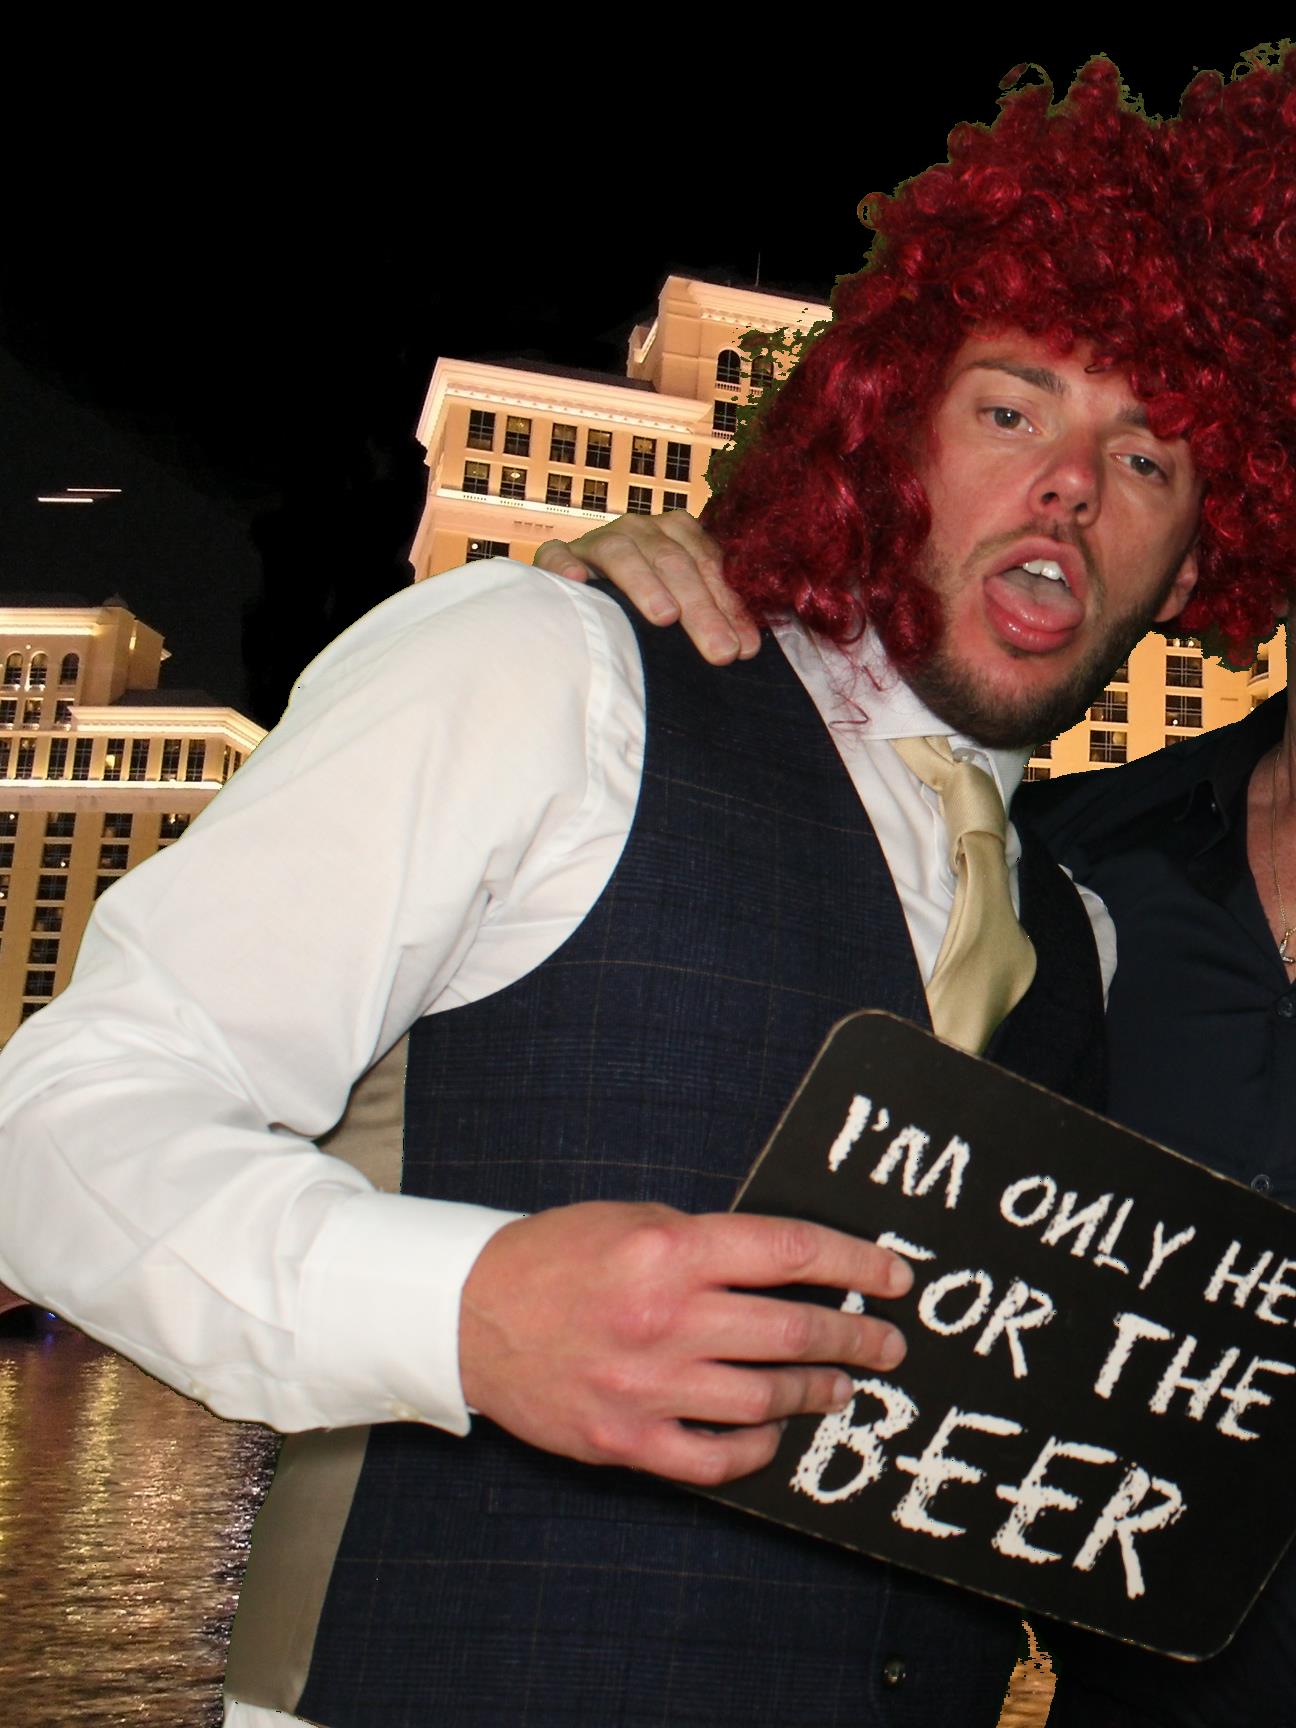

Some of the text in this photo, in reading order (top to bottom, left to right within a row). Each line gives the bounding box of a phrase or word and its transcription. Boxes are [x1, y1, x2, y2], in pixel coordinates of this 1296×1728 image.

[828, 1094, 970, 1209] I'M
[1000, 1175, 1196, 1290] ONLY
[1094, 1312, 1296, 1441] THE
[789, 1379, 1187, 1600] BEER
